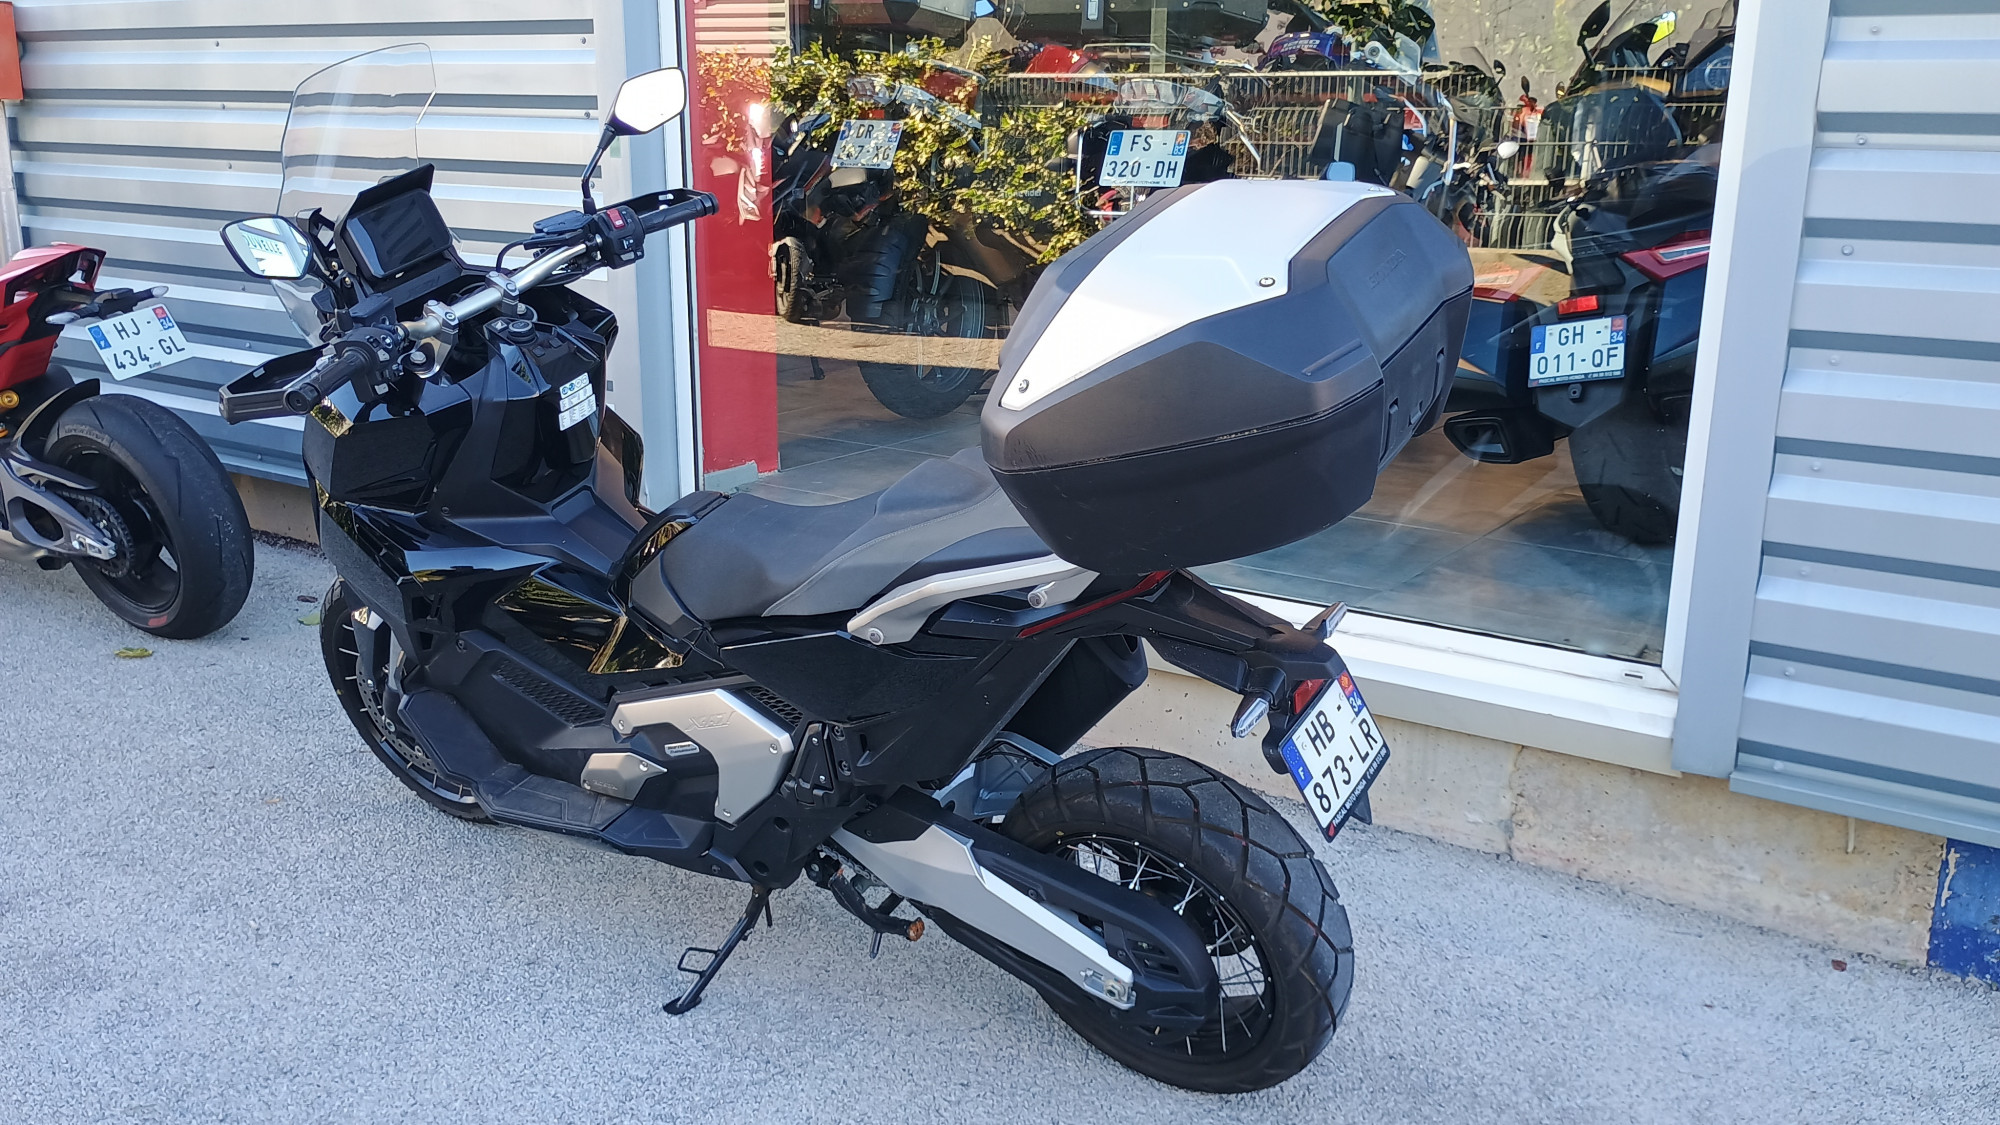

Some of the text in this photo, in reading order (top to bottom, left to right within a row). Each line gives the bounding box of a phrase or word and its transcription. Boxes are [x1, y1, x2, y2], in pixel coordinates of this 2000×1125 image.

[856, 124, 875, 139] DR
[1109, 145, 1117, 155] F
[1130, 135, 1153, 152] FS
[1106, 161, 1178, 179] 320-DH
[113, 318, 140, 340] HJ
[161, 317, 174, 330] 34
[1558, 325, 1584, 346] GH
[1610, 331, 1624, 343] 34
[113, 336, 186, 370] 434-GL
[1537, 346, 1619, 375] 011-QF
[1349, 691, 1363, 712] 34
[1304, 709, 1336, 757] HB
[1298, 766, 1305, 780] F
[1313, 717, 1378, 814] 873-LR
[1332, 806, 1348, 827] PASCAL
[1344, 792, 1357, 810] MOTO
[1353, 778, 1367, 797] HONDA
